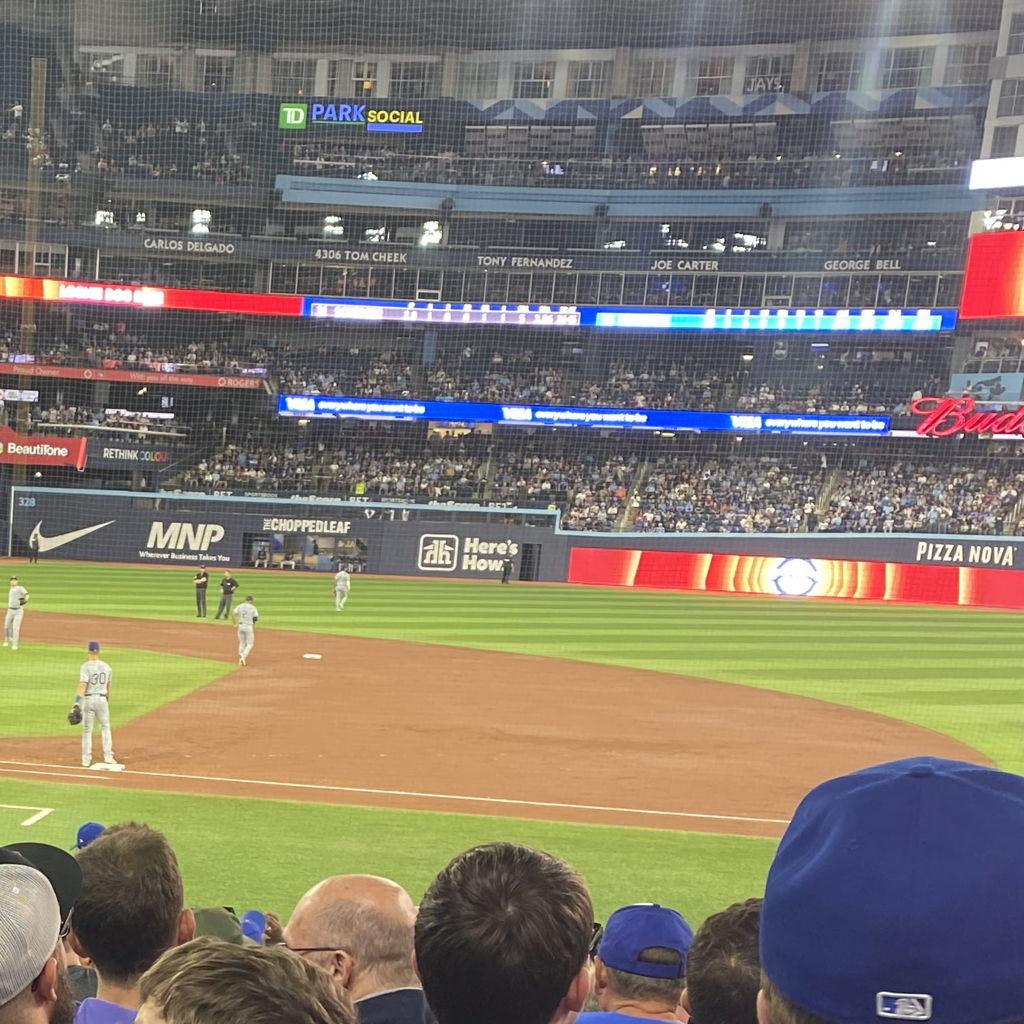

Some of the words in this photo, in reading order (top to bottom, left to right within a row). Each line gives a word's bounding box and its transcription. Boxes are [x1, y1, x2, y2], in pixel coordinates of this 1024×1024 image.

[283, 107, 305, 124] TD
[312, 103, 366, 121] PARK
[367, 110, 423, 124] SOCIAL
[144, 239, 183, 251] CARLOS
[187, 241, 235, 254] DELGADO
[314, 249, 342, 261] 4306
[344, 251, 370, 262] TOM
[373, 252, 407, 263] CHEEK
[477, 256, 507, 266] TONY
[511, 257, 573, 269] FERNANDEZ
[650, 260, 673, 271] JOE
[677, 260, 719, 271] CARTER
[824, 259, 870, 271] GEORGE
[876, 259, 901, 270] BELL
[227, 379, 260, 388] ROGERS
[7, 442, 68, 457] BeautiTone
[103, 447, 139, 461] RETHINK
[139, 450, 172, 462] COLOU
[147, 521, 225, 551] MNP
[464, 537, 519, 556] Here's
[139, 551, 170, 560] Wherever
[171, 552, 197, 561] Business
[198, 553, 216, 561] Takes
[217, 554, 230, 562] You
[916, 541, 964, 562] PIZZA
[968, 545, 1014, 567] NOVA
[90, 672, 106, 686] 30
